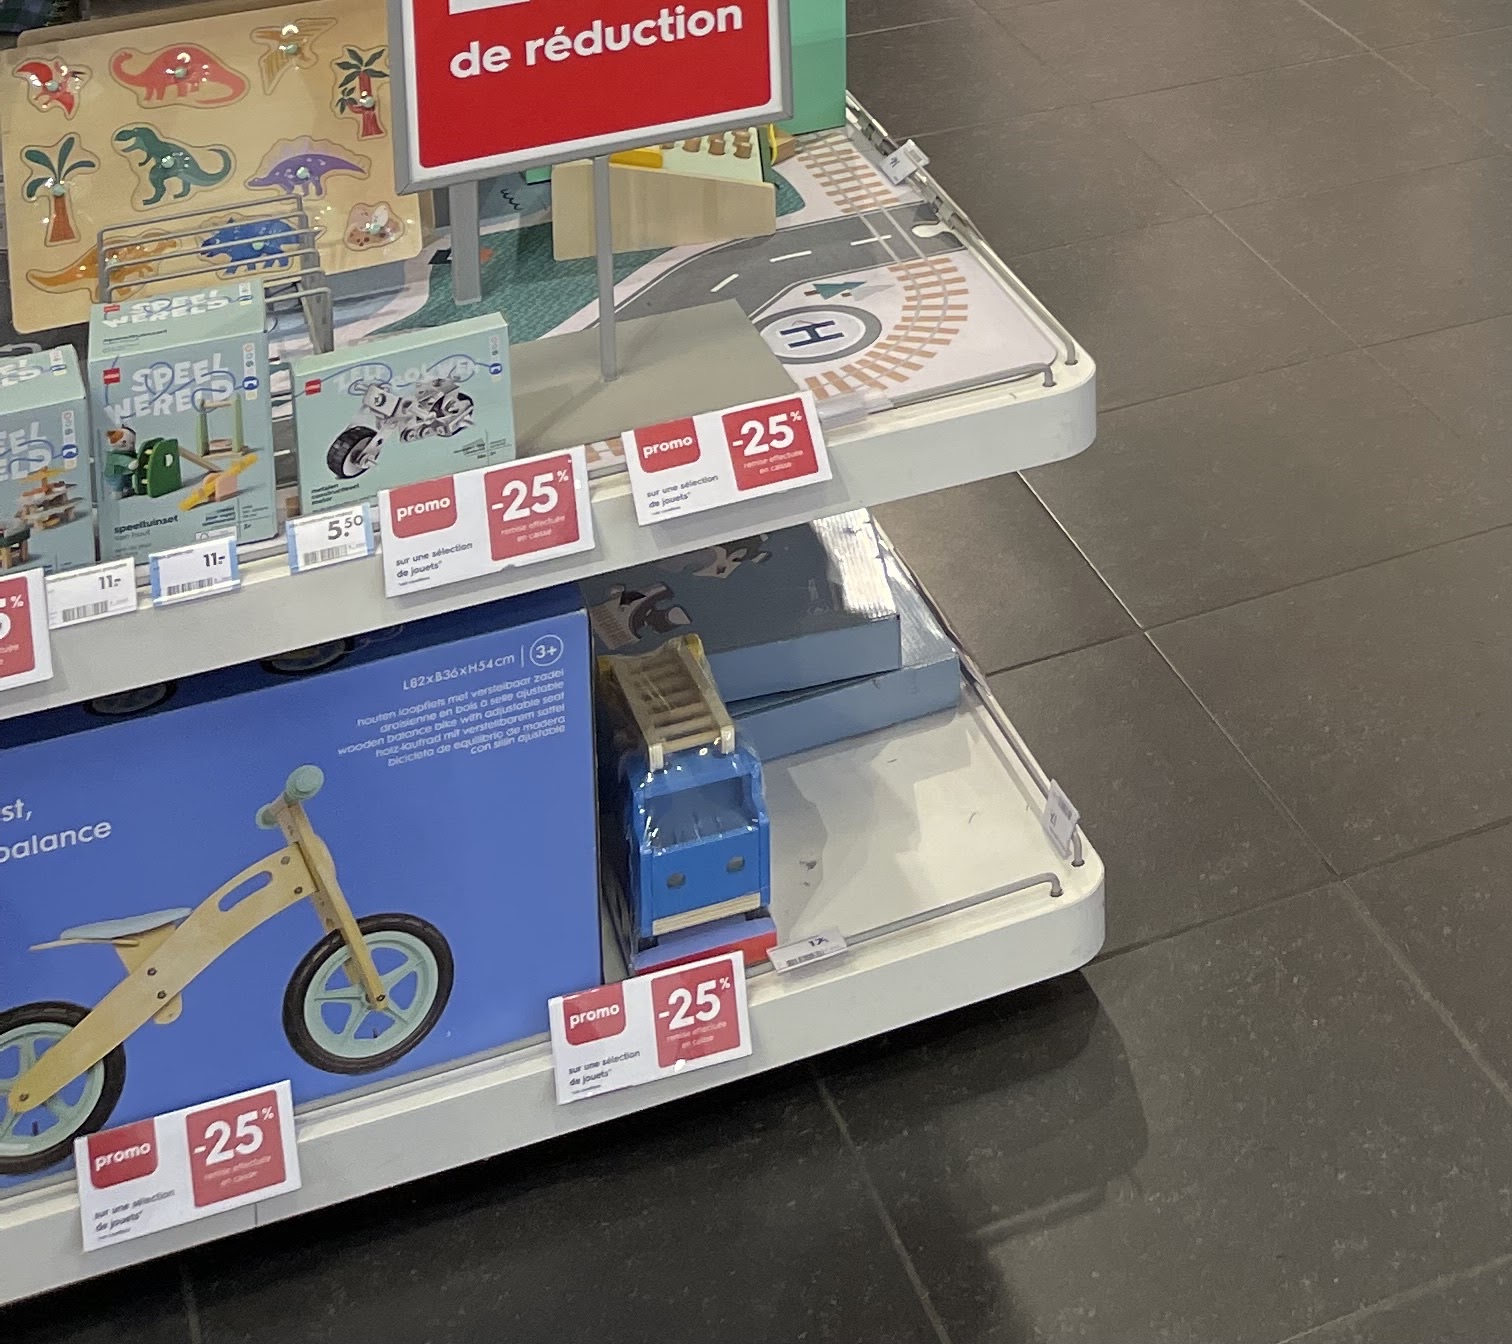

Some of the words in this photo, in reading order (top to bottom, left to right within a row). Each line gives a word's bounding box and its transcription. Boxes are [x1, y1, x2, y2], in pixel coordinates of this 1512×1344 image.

[449, 41, 511, 79] de
[526, 4, 743, 66] réduction
[732, 410, 802, 457] -25%
[643, 435, 693, 459] promo
[491, 469, 569, 522] -25%
[662, 485, 678, 493] une
[680, 474, 719, 490] sélection
[396, 496, 451, 521] promo
[649, 500, 659, 508] de
[327, 515, 364, 541] 5.50
[396, 557, 411, 566] sur
[413, 552, 430, 562] une
[432, 541, 473, 558] sélection
[397, 569, 409, 578] de
[337, 736, 385, 756] wooden
[569, 1004, 620, 1029] promo
[658, 977, 731, 1031] -25%
[193, 1106, 274, 1166] -25%
[95, 1142, 151, 1171] promo
